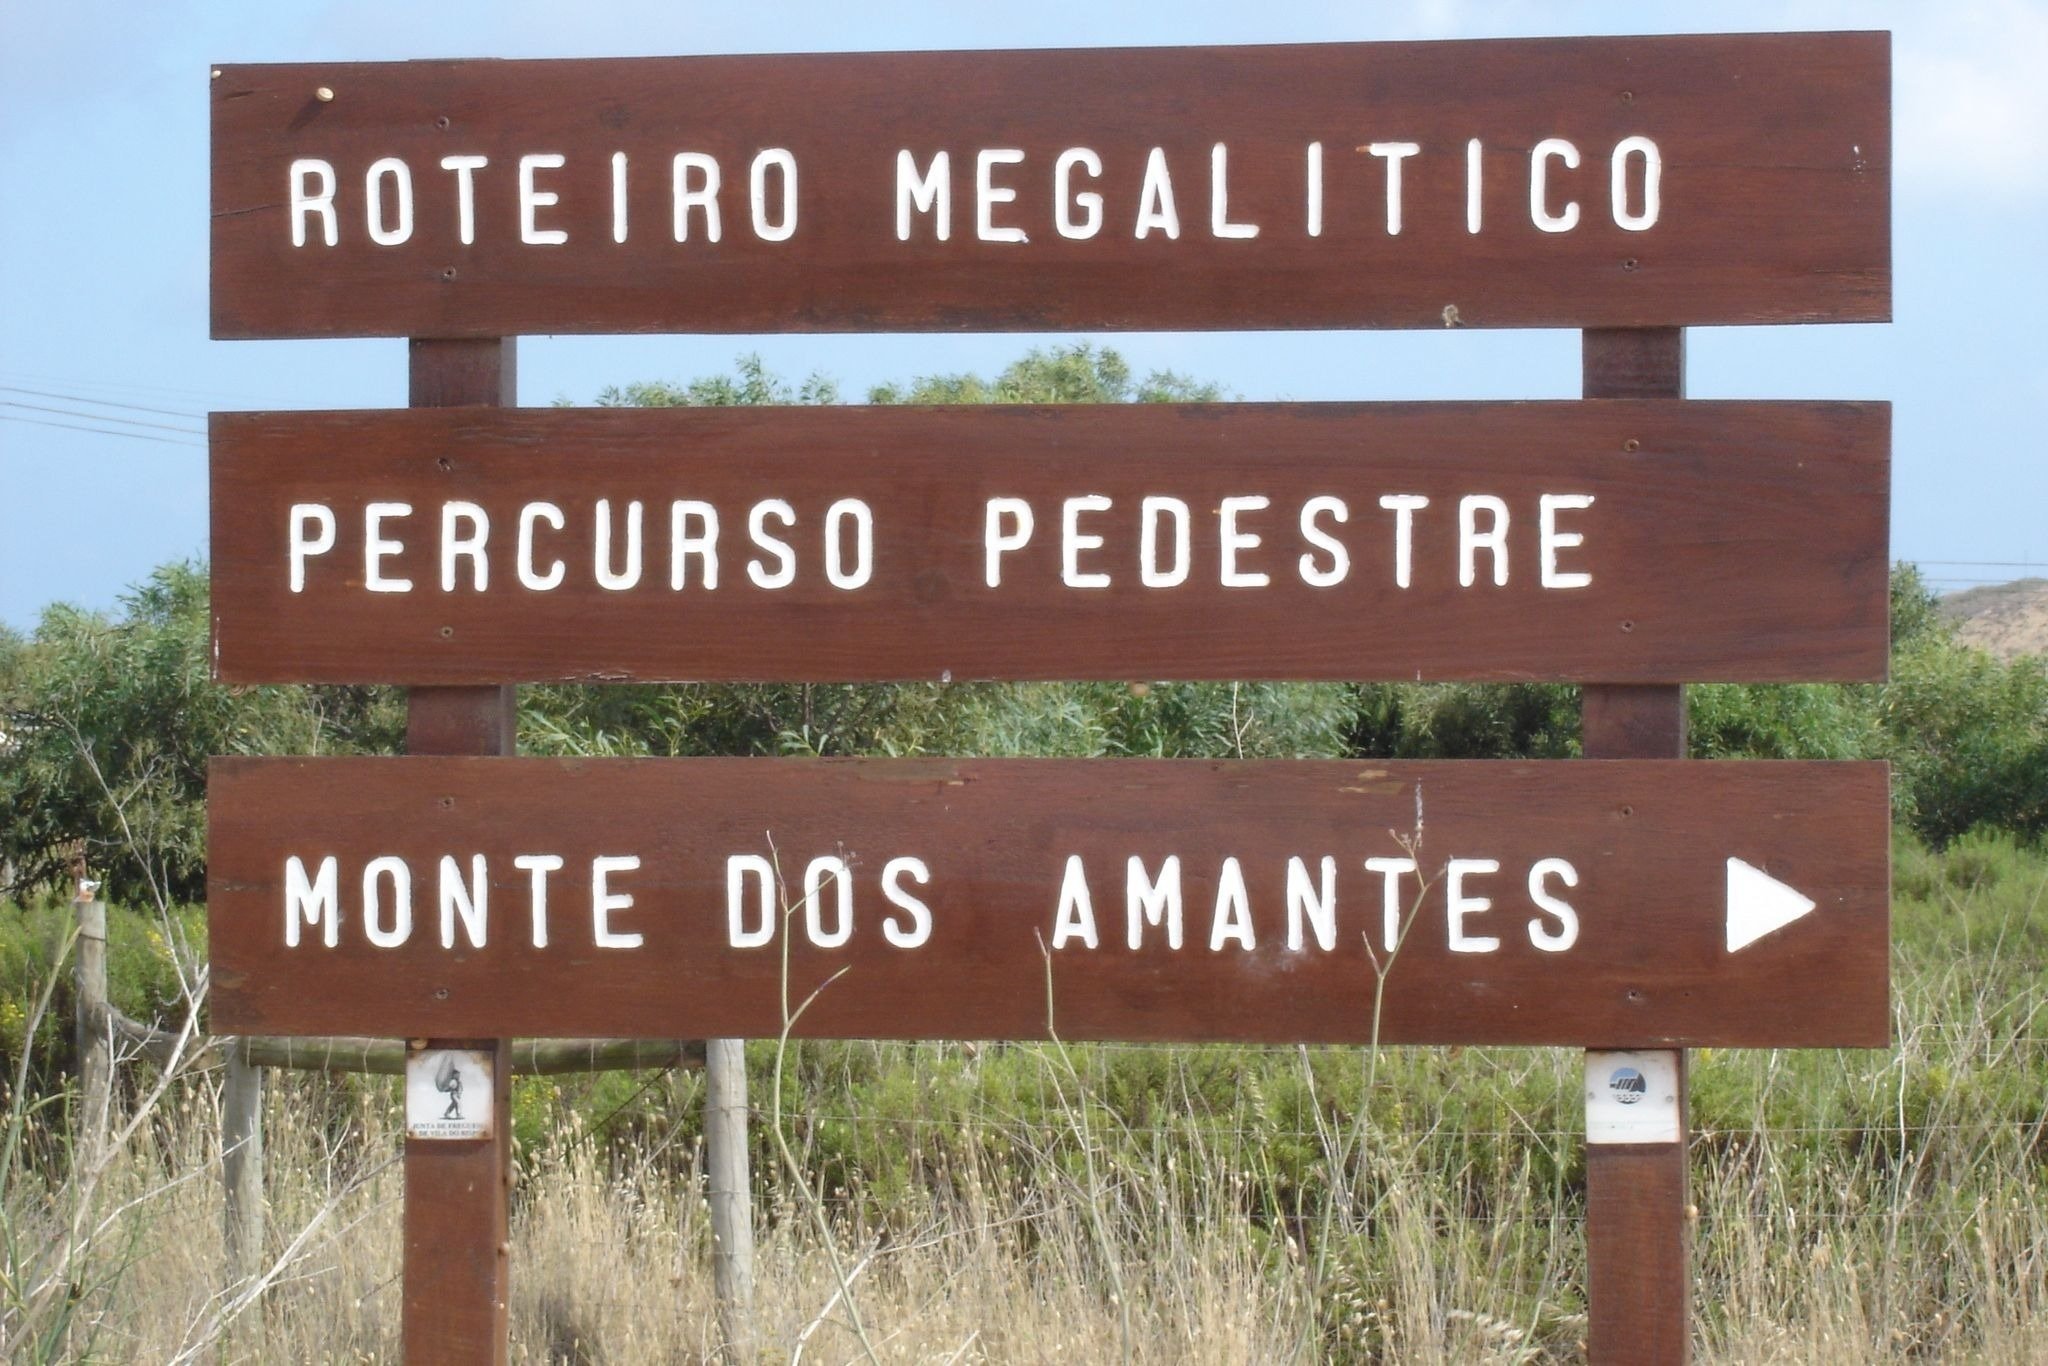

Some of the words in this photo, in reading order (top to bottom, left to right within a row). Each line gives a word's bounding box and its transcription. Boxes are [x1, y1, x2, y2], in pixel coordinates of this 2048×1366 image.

[289, 151, 797, 247] ROTEIRO
[897, 136, 1661, 243] MEGALITICO
[289, 498, 873, 593] PERCURSO
[984, 493, 1595, 588] PEDESTRE
[284, 854, 643, 949] MONTE
[726, 855, 932, 949] DOS
[1052, 855, 1579, 954] AMANTES
